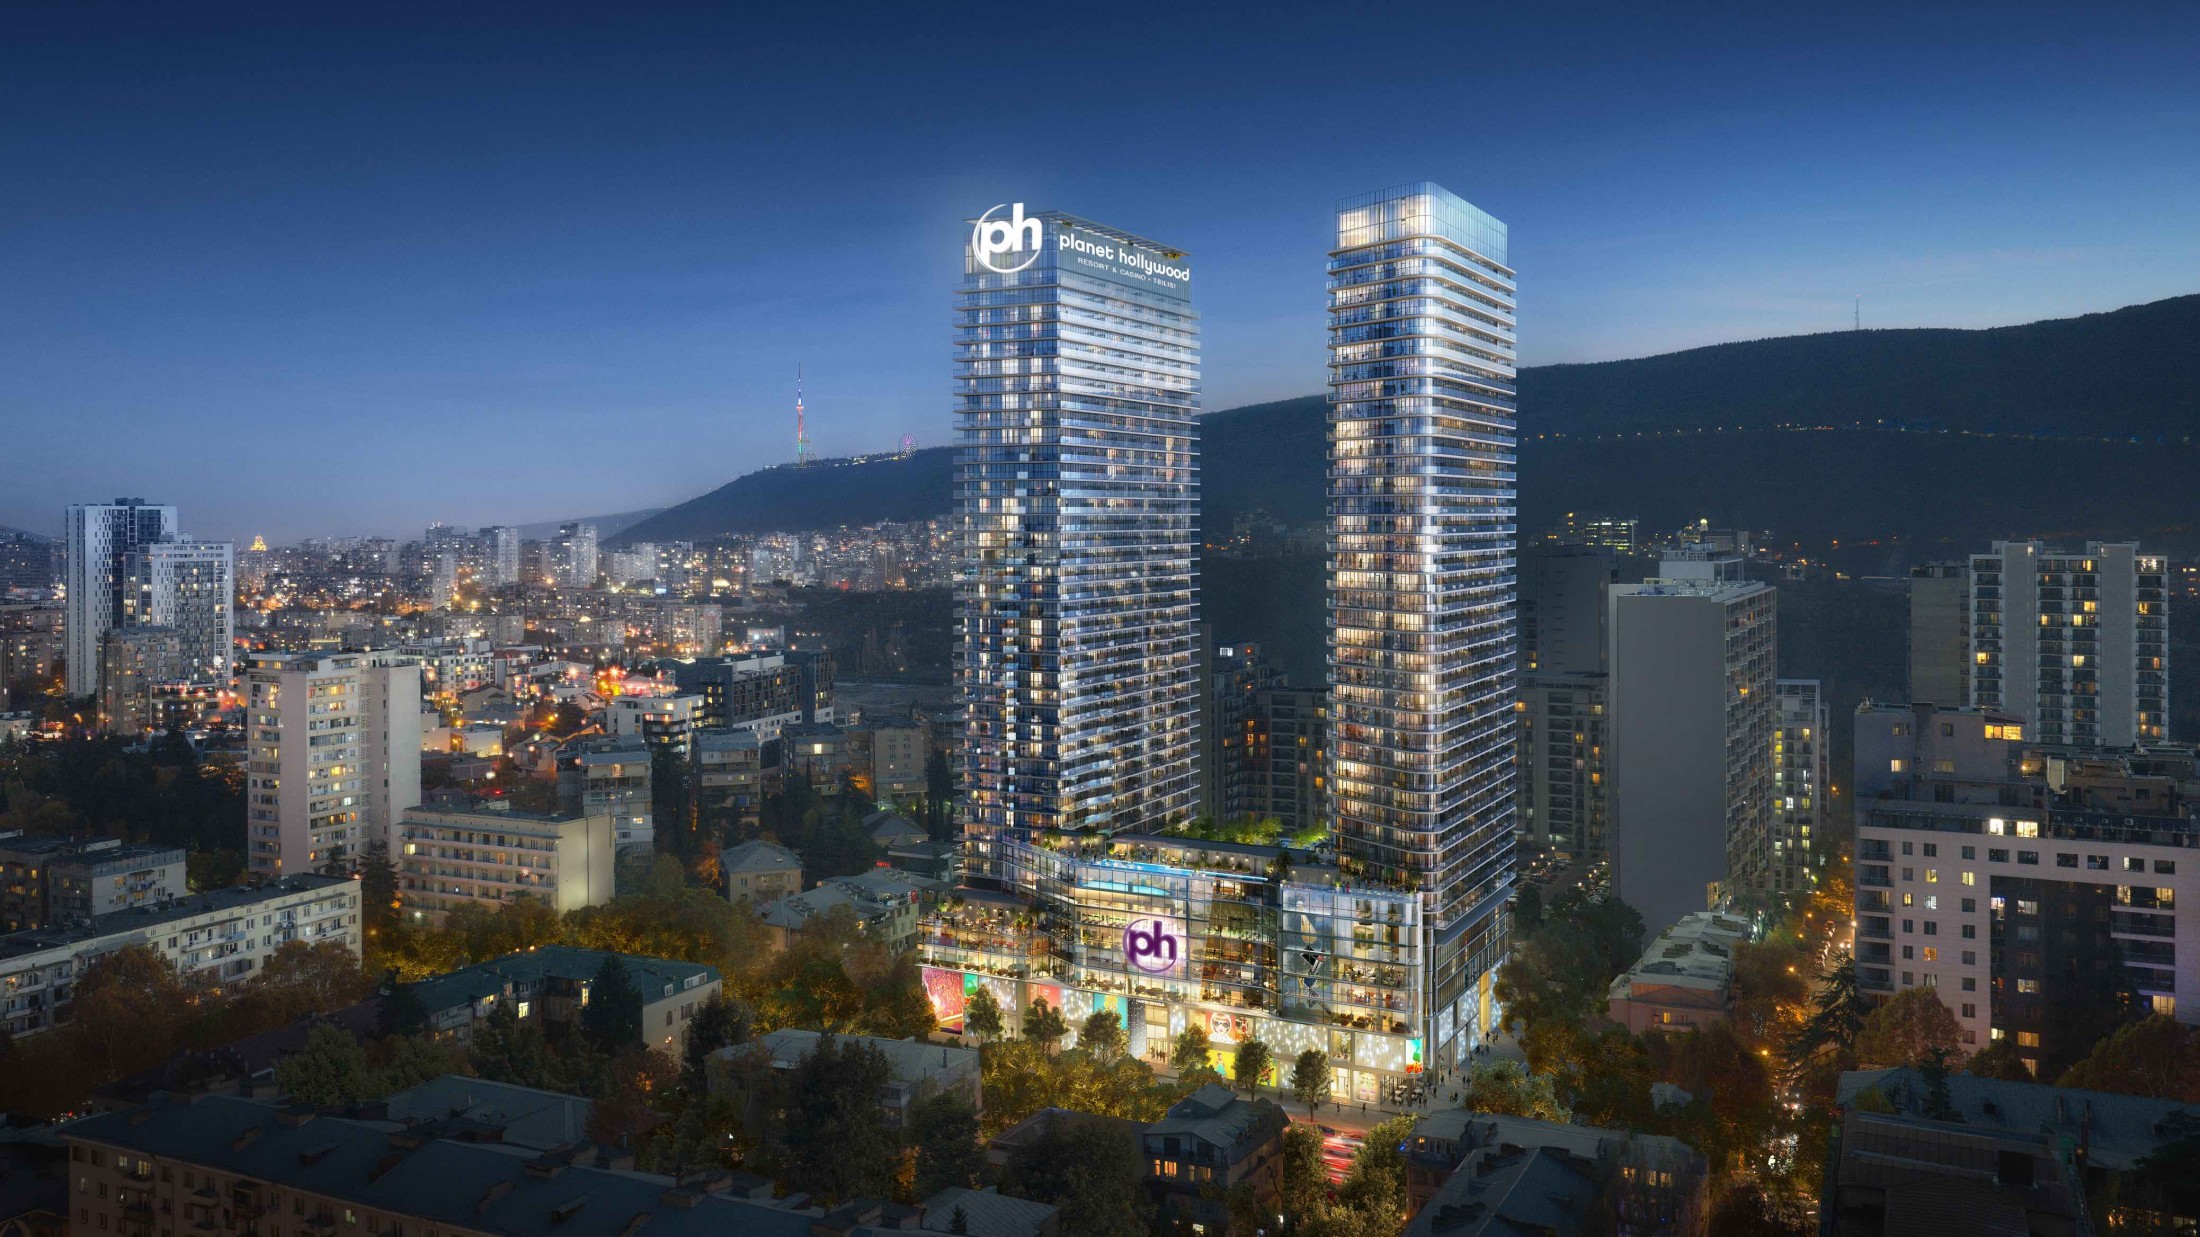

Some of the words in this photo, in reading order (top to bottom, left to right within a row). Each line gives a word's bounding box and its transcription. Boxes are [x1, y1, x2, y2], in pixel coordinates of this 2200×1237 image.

[981, 202, 1042, 266] ph
[1059, 233, 1114, 260] planet
[1119, 248, 1190, 282] hollywood
[1077, 257, 1109, 271] RESORT
[1119, 269, 1146, 281] CASINO
[1153, 277, 1176, 289] TBILISI
[1128, 920, 1177, 963] ph
